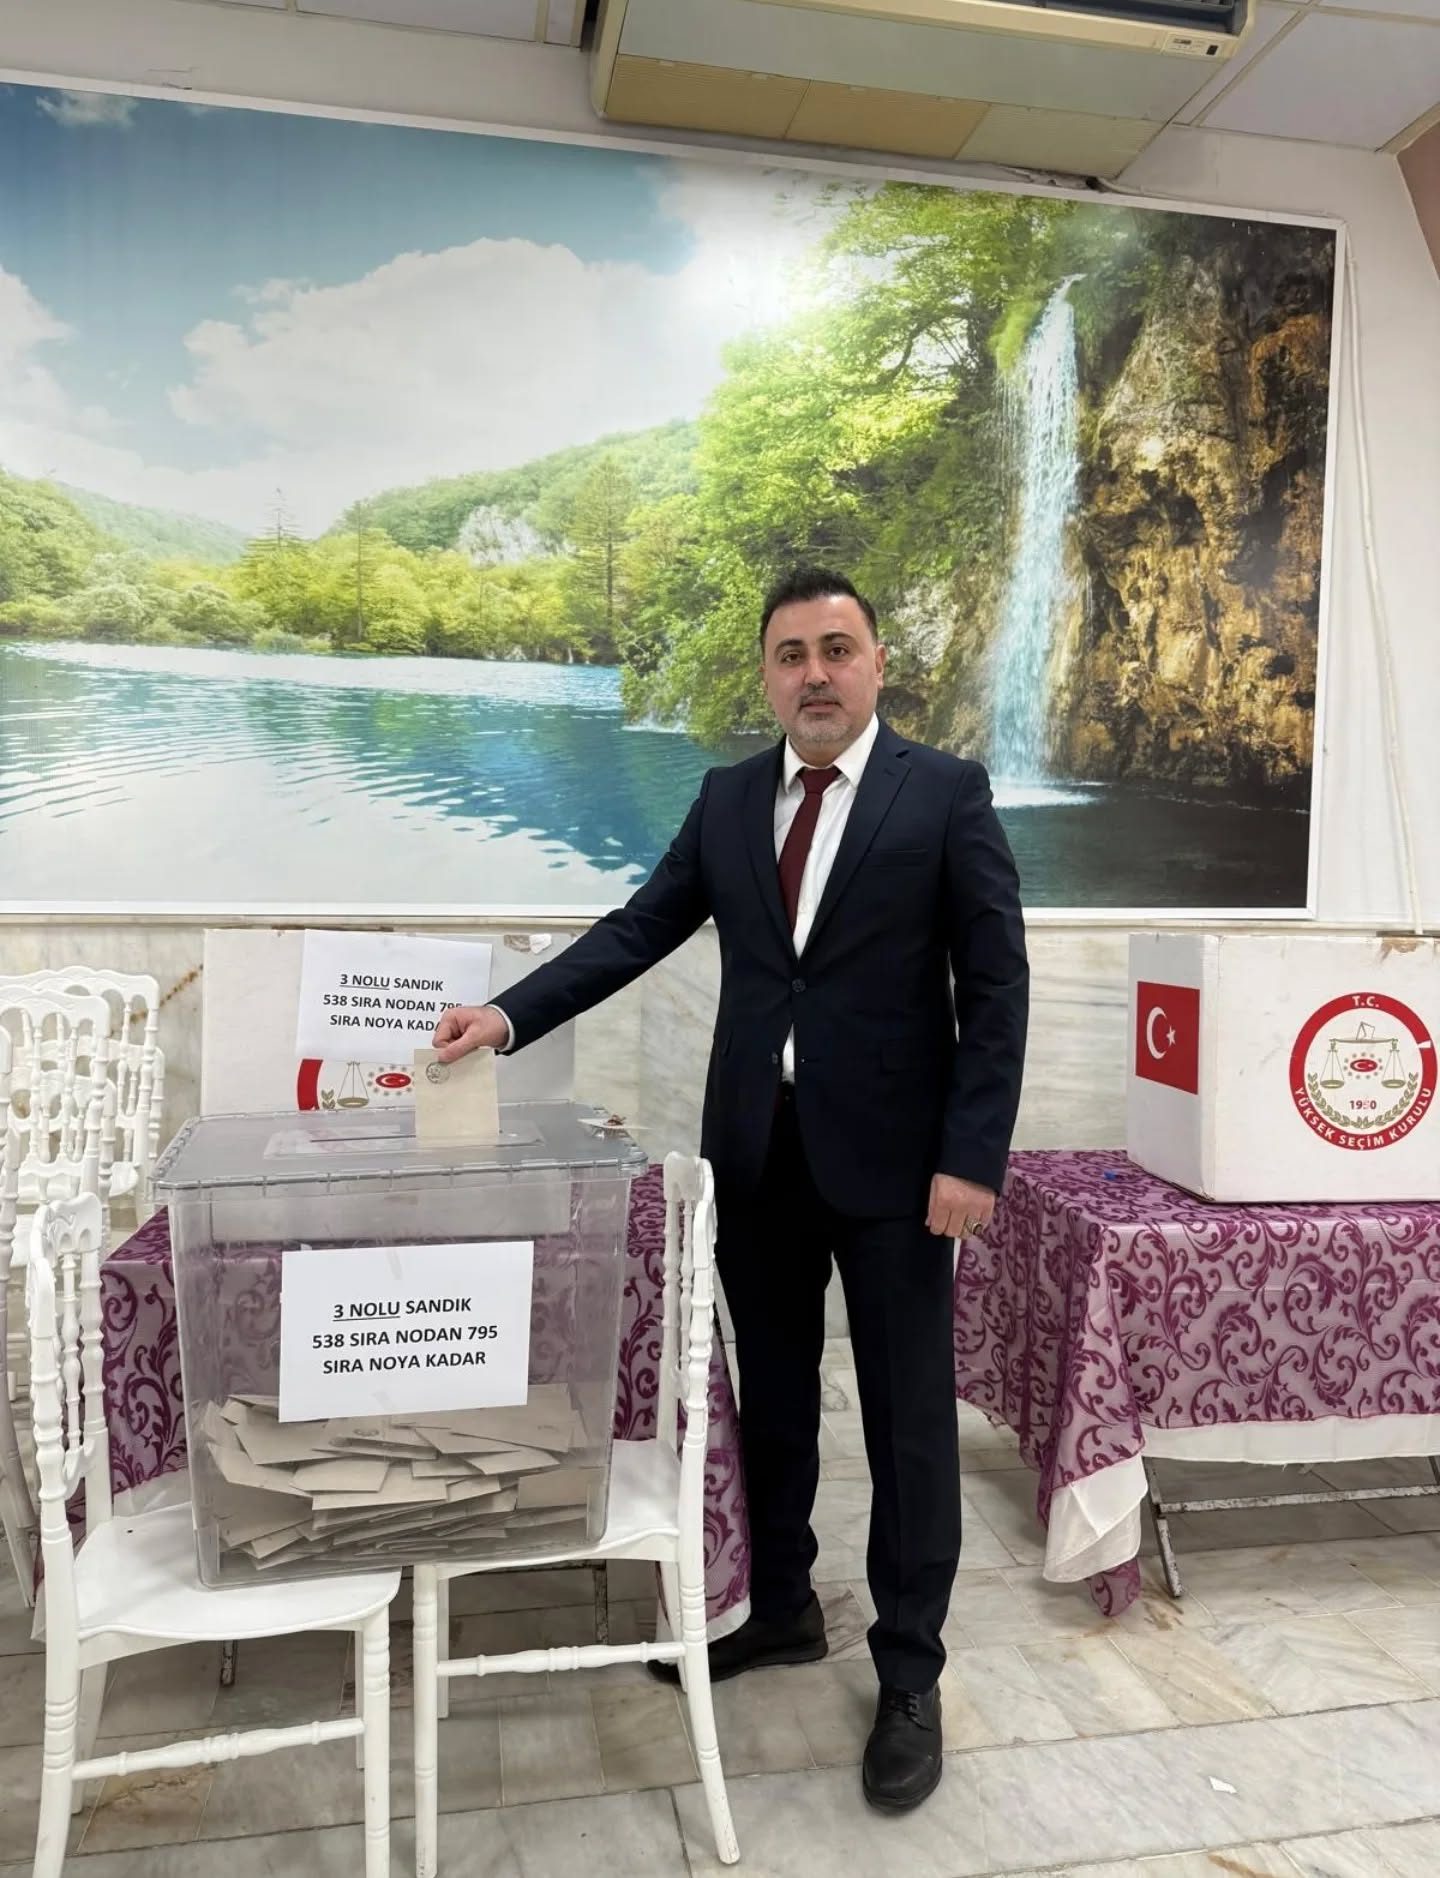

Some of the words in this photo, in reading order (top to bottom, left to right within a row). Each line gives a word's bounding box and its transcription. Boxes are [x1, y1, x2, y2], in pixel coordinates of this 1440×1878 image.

[340, 974, 348, 985] 3
[352, 975, 390, 988] NOLU
[394, 978, 444, 991] SANDIK
[323, 994, 348, 1006] 538
[351, 996, 381, 1009] SIRA
[385, 999, 436, 1012] NODAN
[1352, 995, 1380, 1008] T.C.
[330, 1014, 361, 1027] SIRA
[365, 1017, 403, 1030] NOYA
[407, 1019, 440, 1031] KAD
[1294, 1086, 1335, 1140] YÜKSEK
[1339, 1134, 1385, 1150] SEÇİM
[1389, 1088, 1432, 1141] KURULU
[333, 1304, 344, 1318] 3
[350, 1301, 400, 1318] NOLU
[405, 1298, 472, 1315] SANDIK
[312, 1334, 344, 1349] 538
[349, 1331, 390, 1347] SIRA
[396, 1327, 462, 1344] NODAN
[467, 1325, 498, 1340] 795
[323, 1358, 364, 1374] SIRA
[370, 1355, 420, 1372] NOYA
[426, 1351, 486, 1368] KADAR
